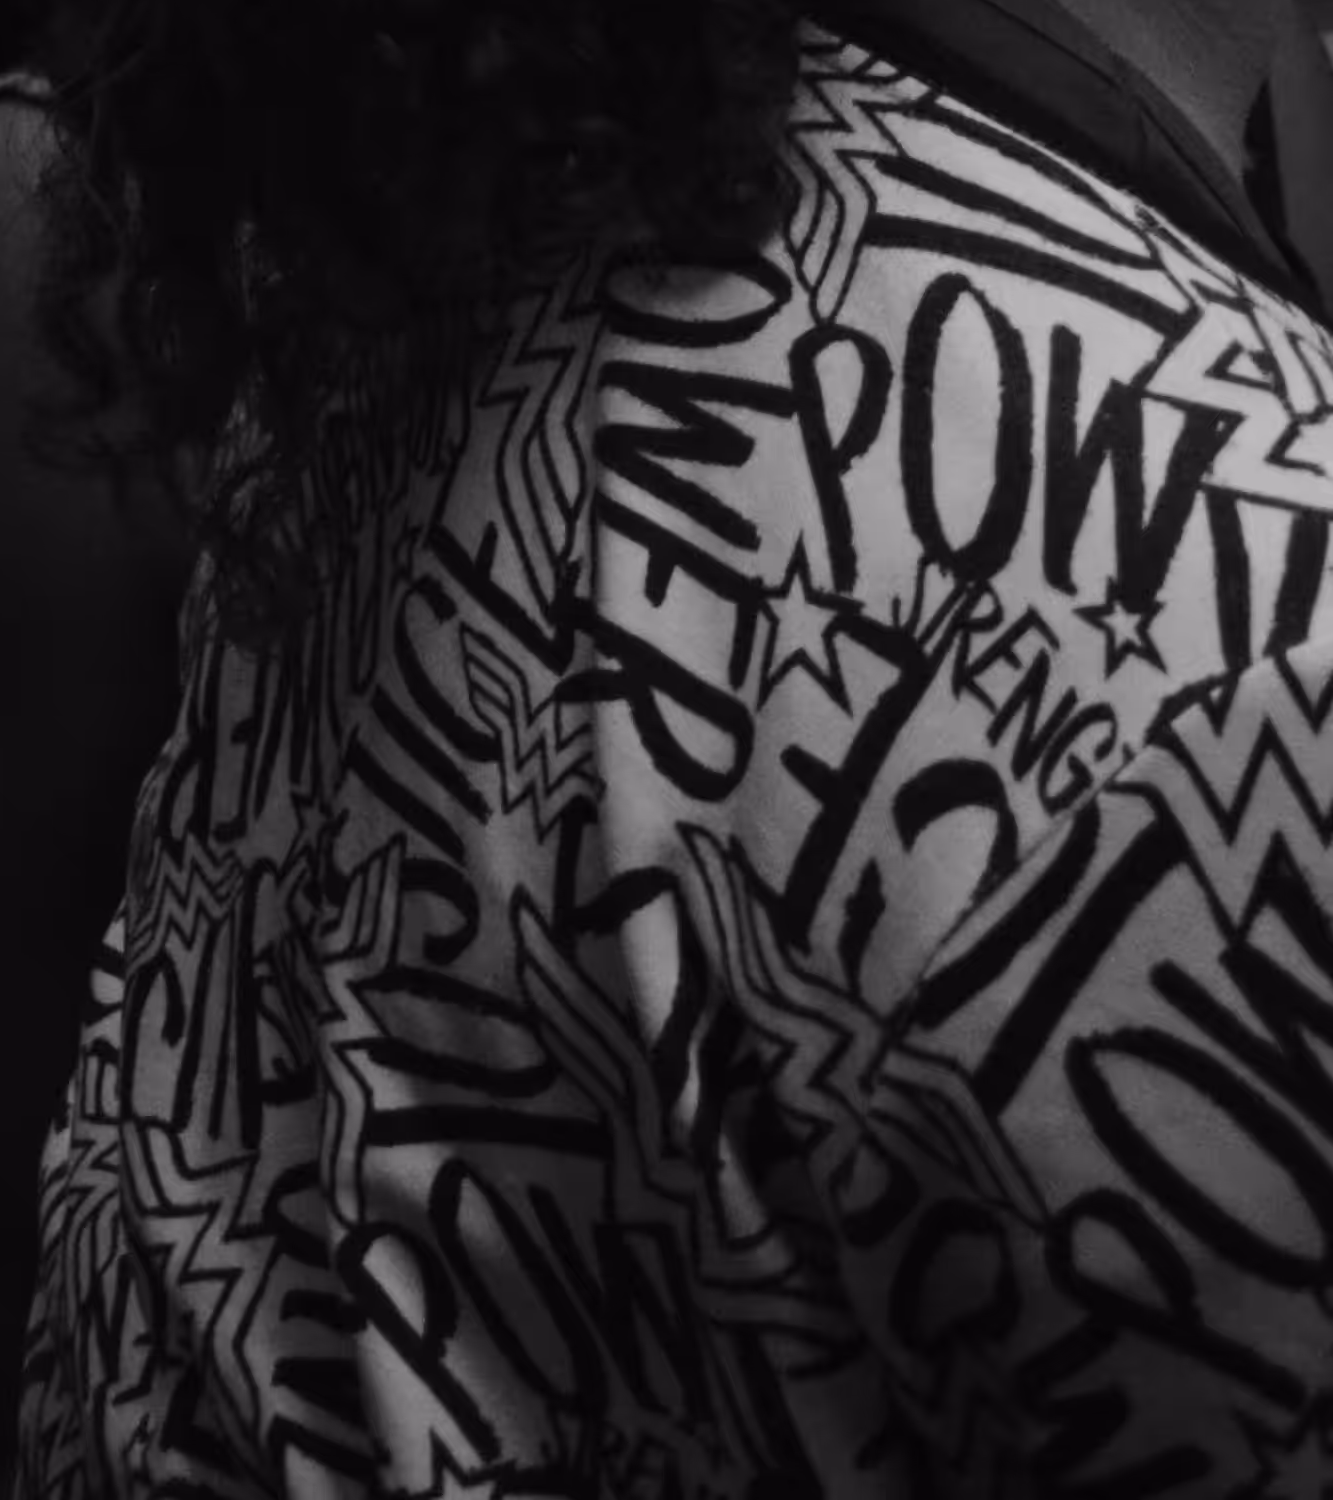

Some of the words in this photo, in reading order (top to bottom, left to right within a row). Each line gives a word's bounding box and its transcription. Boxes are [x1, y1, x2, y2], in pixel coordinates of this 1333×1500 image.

[550, 255, 800, 800] OWER
[788, 270, 1331, 675] POW
[890, 558, 1133, 815] STRENG
